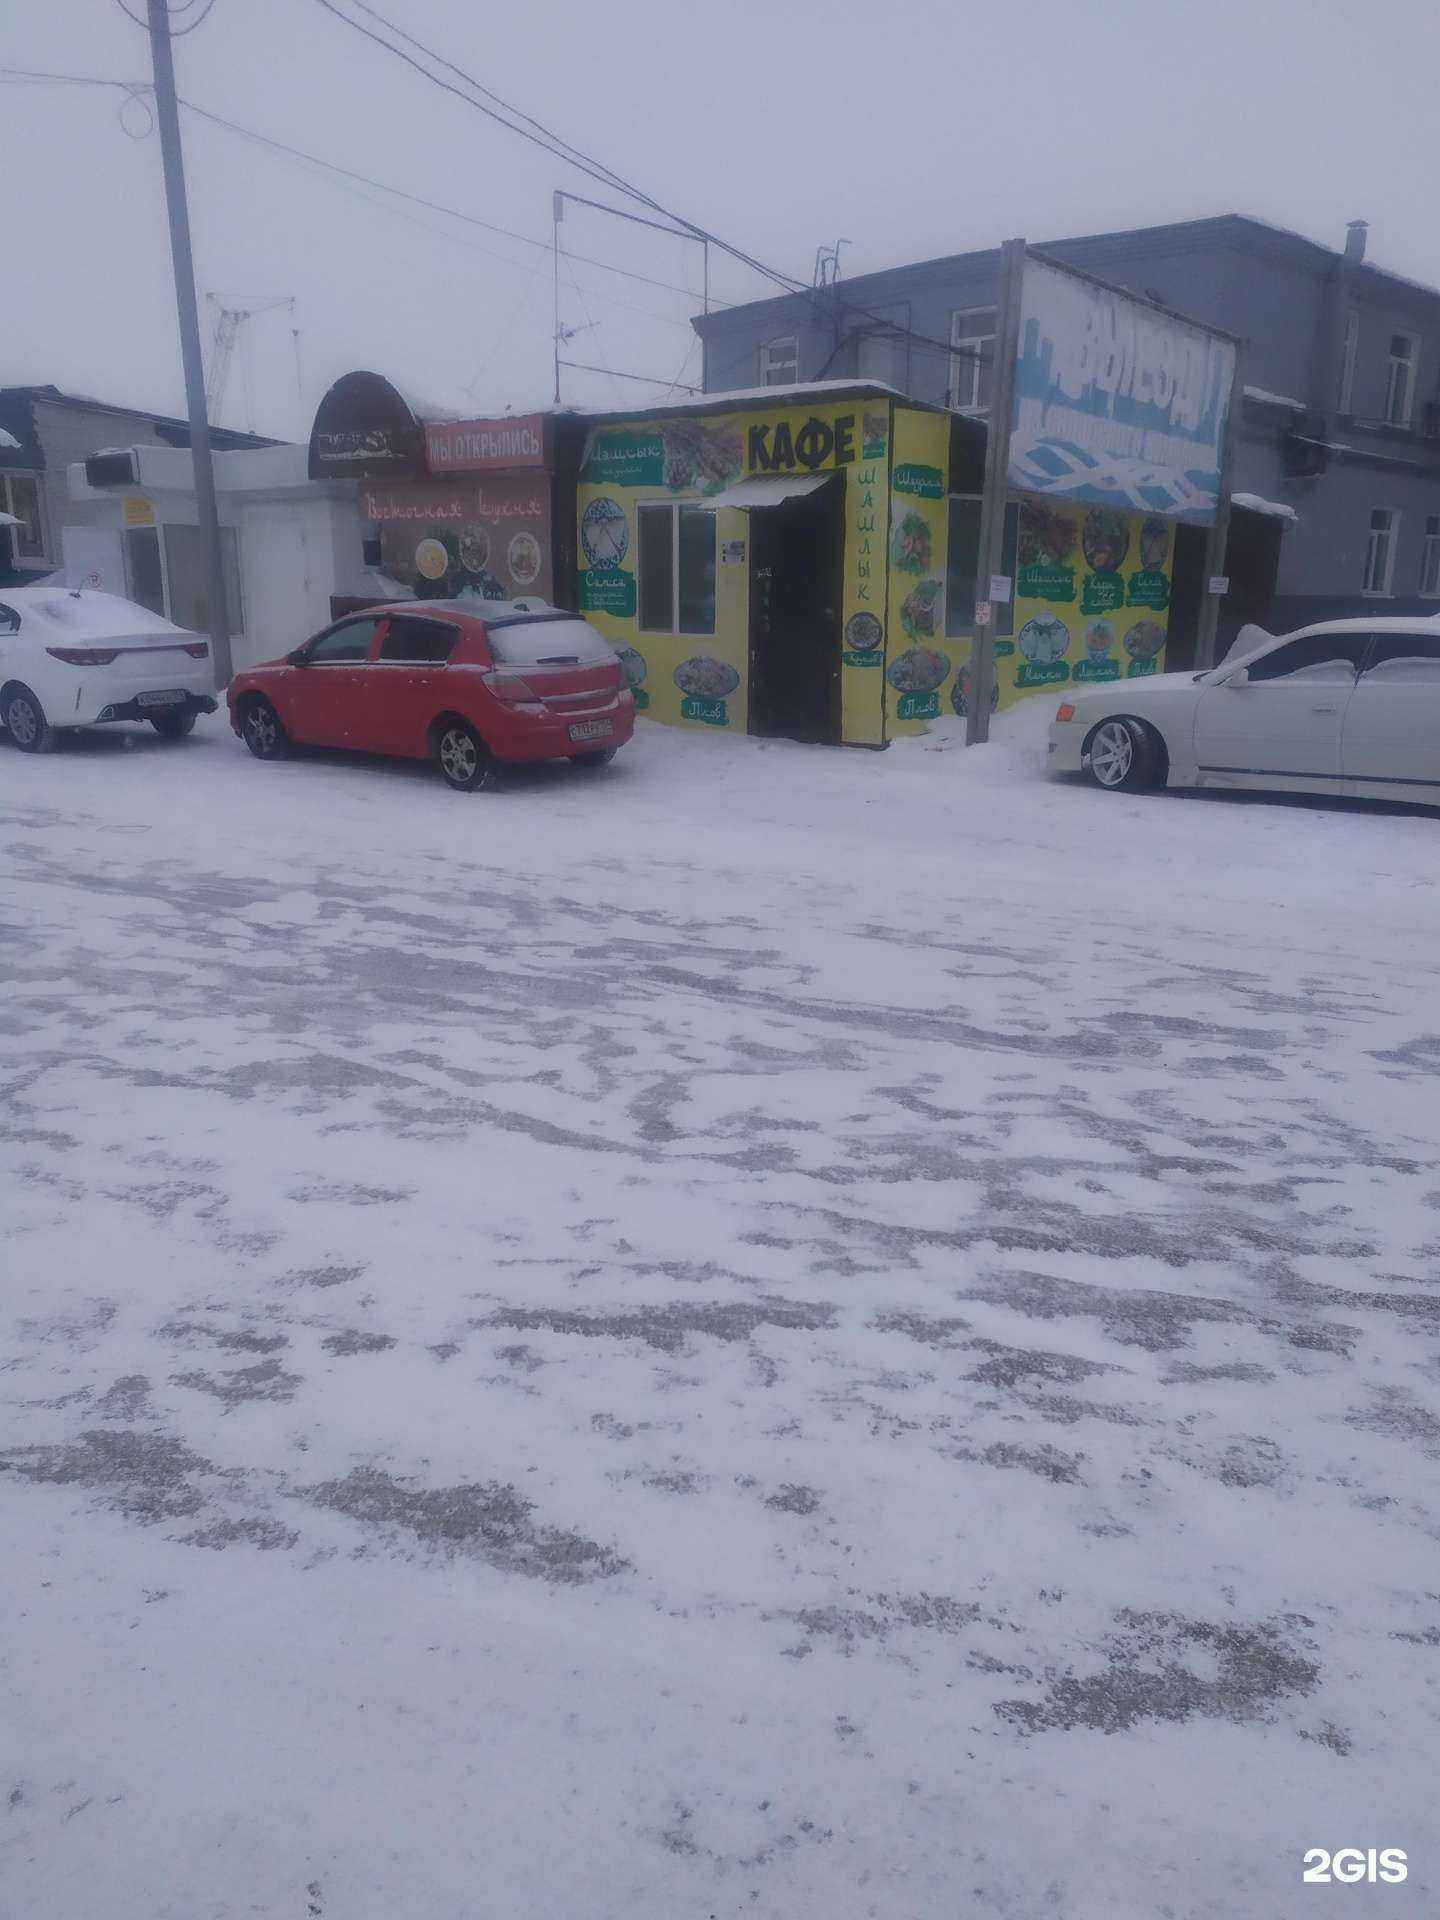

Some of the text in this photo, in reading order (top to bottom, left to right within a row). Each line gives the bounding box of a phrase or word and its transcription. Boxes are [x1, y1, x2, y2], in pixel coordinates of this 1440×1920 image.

[431, 428, 540, 464] МЫ ОТКРЫЛИСЬ
[748, 414, 856, 471] КАФЕ
[858, 468, 879, 601] ШАШЛЫК
